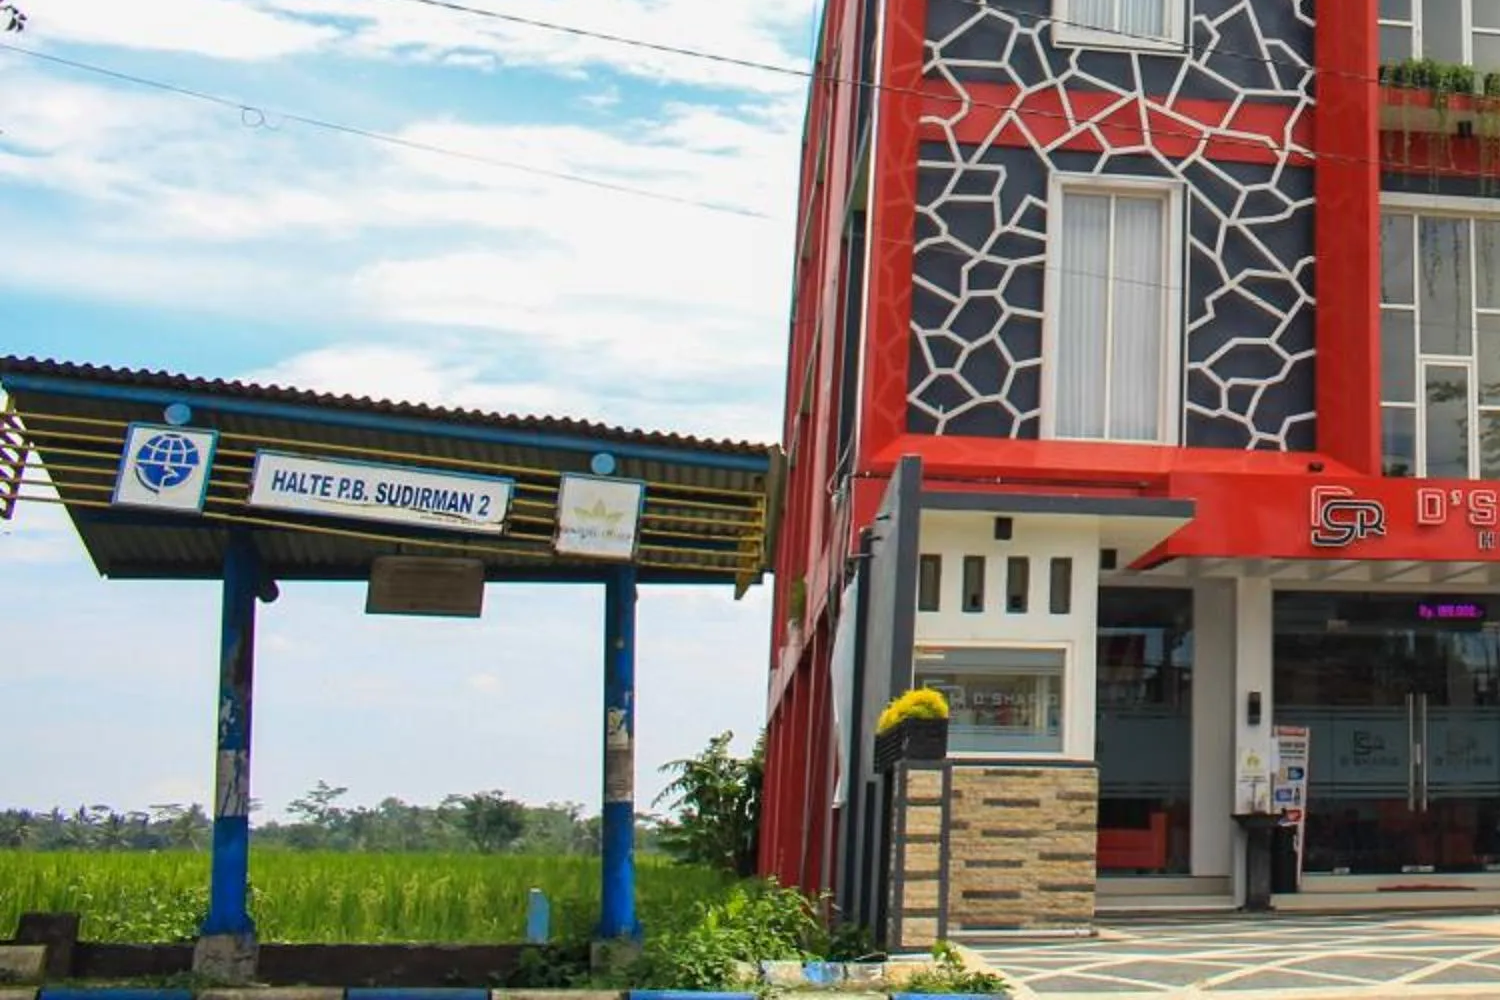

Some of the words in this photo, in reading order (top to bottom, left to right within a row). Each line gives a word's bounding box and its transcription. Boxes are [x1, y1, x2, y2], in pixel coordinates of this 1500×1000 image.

[271, 469, 334, 498] HALTE
[337, 478, 369, 502] P.B.
[375, 482, 475, 515] SUDIRMAN
[477, 494, 491, 517] 2
